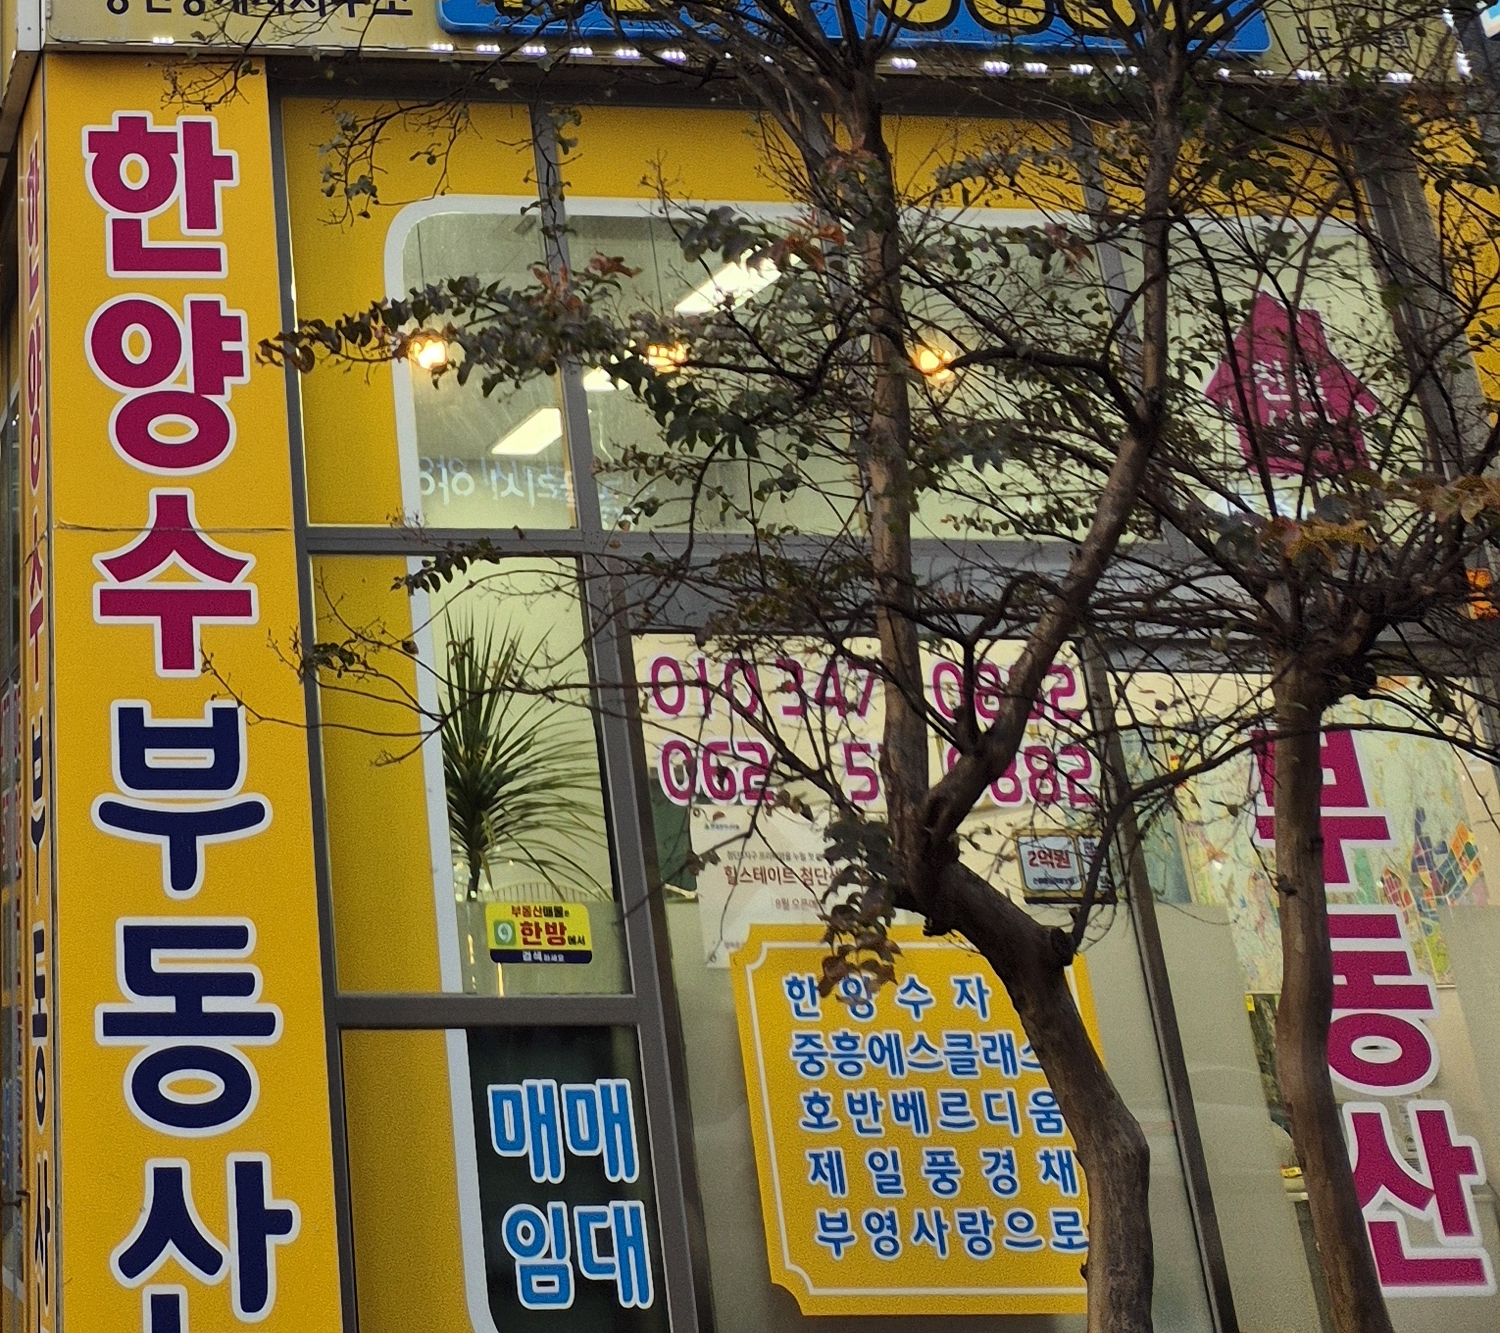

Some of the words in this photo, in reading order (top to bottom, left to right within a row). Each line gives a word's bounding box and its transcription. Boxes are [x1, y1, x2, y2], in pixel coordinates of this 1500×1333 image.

[488, 1079, 639, 1183] 매매
[801, 1089, 1066, 1136] 호반베르디움
[807, 1147, 1079, 1197] 제일풍경채
[503, 1201, 654, 1308] 임대
[816, 1207, 1090, 1258] 부영사랑으로
